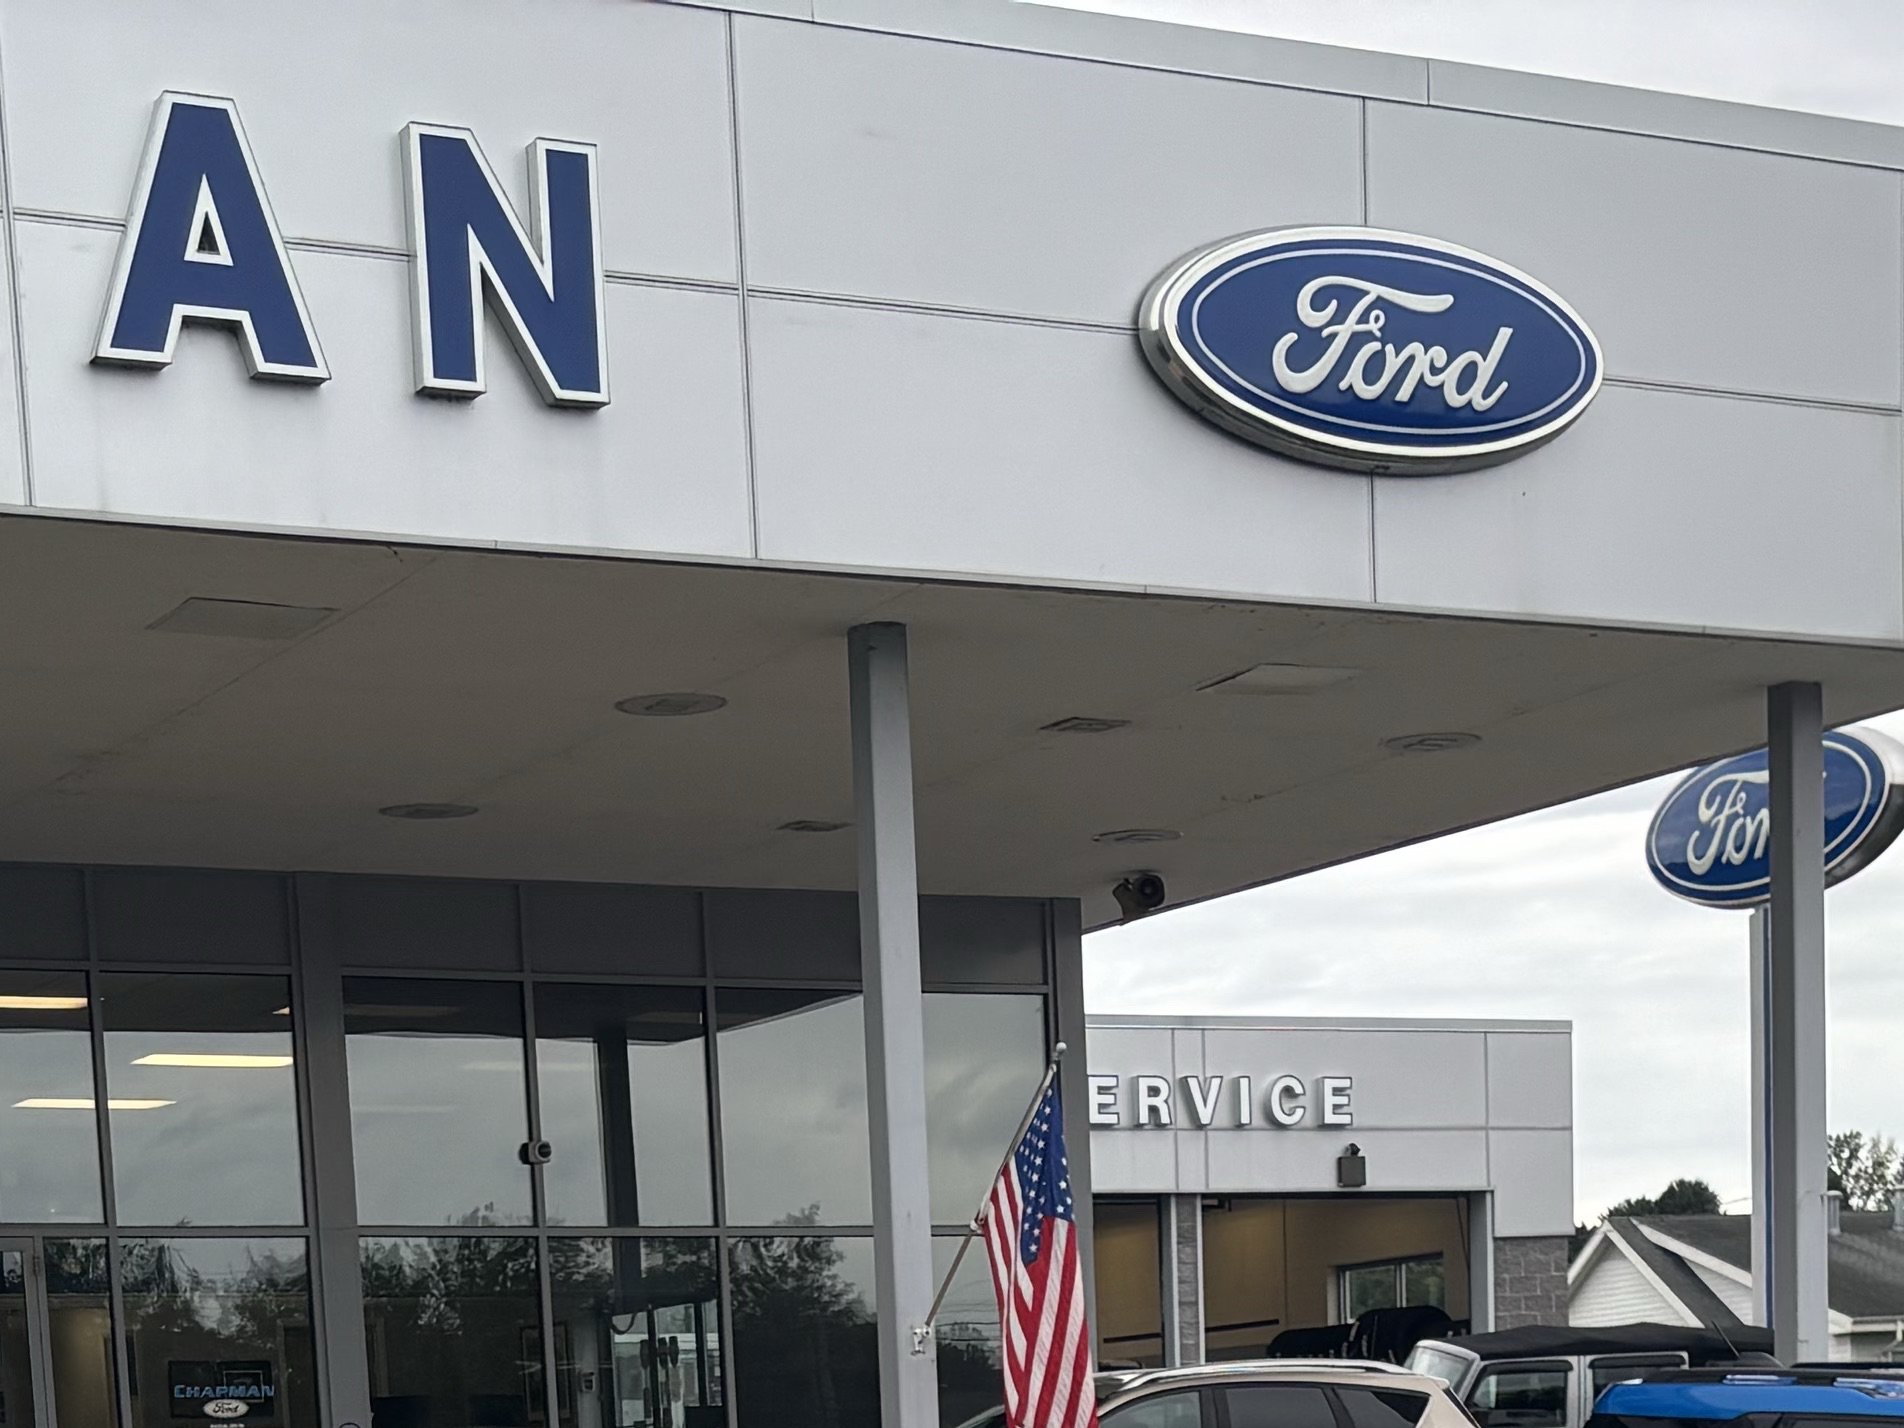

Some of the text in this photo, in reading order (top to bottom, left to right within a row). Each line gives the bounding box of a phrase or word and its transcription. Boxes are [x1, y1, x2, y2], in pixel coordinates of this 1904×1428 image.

[1272, 275, 1514, 412] Ford
[1087, 1075, 1352, 1126] ERVICE
[173, 1384, 275, 1399] CHAPMAN
